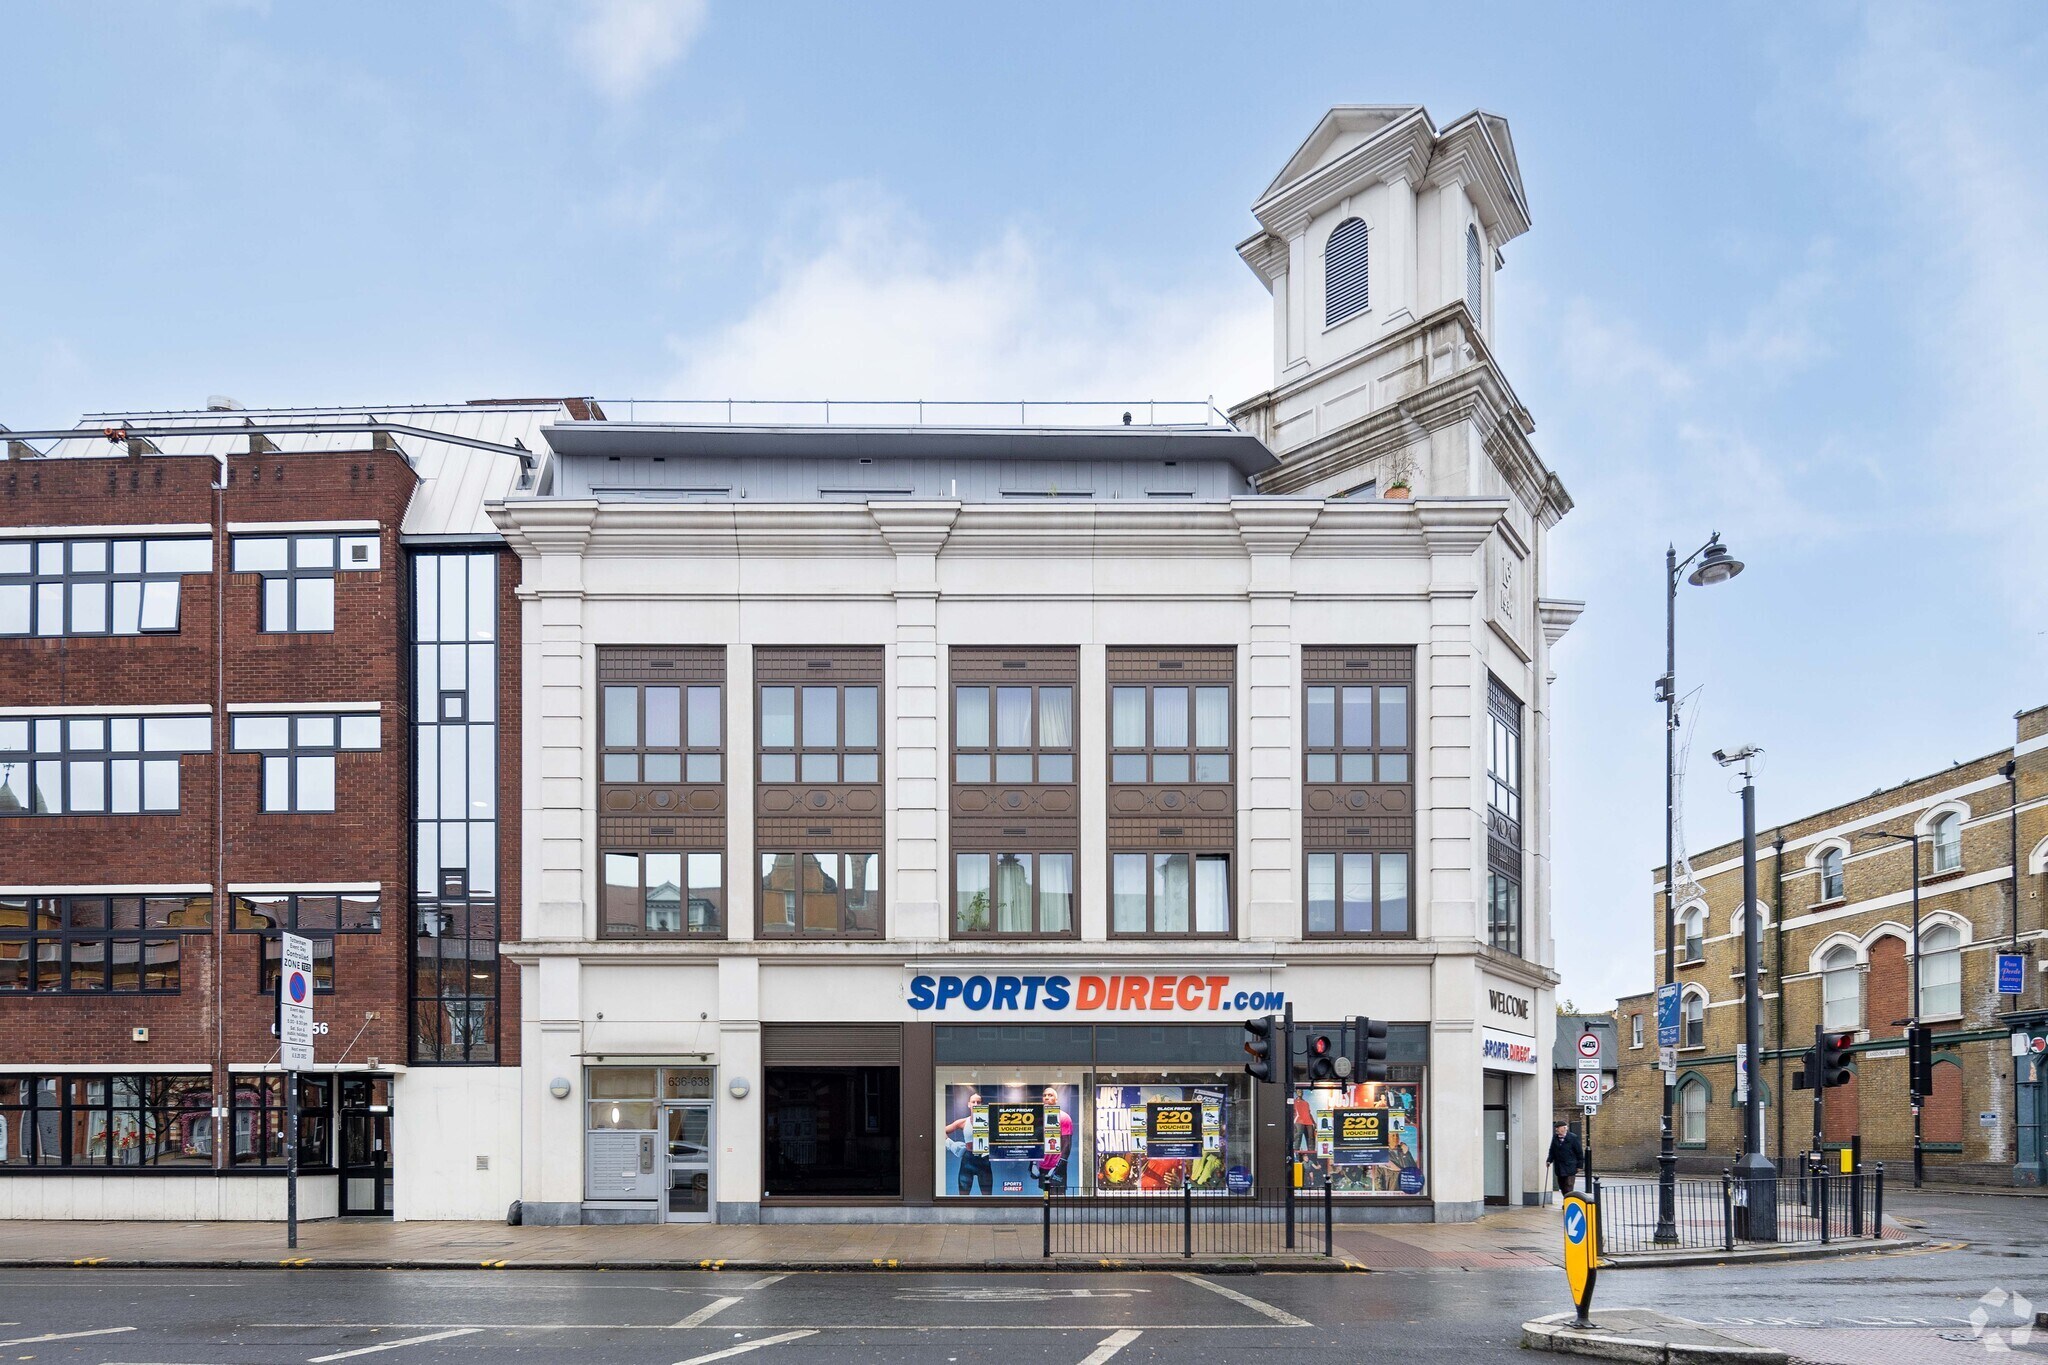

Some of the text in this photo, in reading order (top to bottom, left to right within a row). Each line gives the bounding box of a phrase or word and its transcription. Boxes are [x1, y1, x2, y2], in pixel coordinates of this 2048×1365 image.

[287, 949, 309, 961] Controlled
[284, 958, 300, 970] ZONE
[907, 975, 1071, 1011] SPORTS
[1489, 989, 1528, 1019] WELCOME
[1484, 1039, 1509, 1060] SPORTS
[669, 1077, 710, 1087] 636-638
[1584, 1080, 1596, 1089] 20
[999, 1113, 1034, 1125] £20
[1097, 1108, 1131, 1130] GETTIN
[1157, 1111, 1193, 1123] £20
[1343, 1117, 1379, 1129] £20
